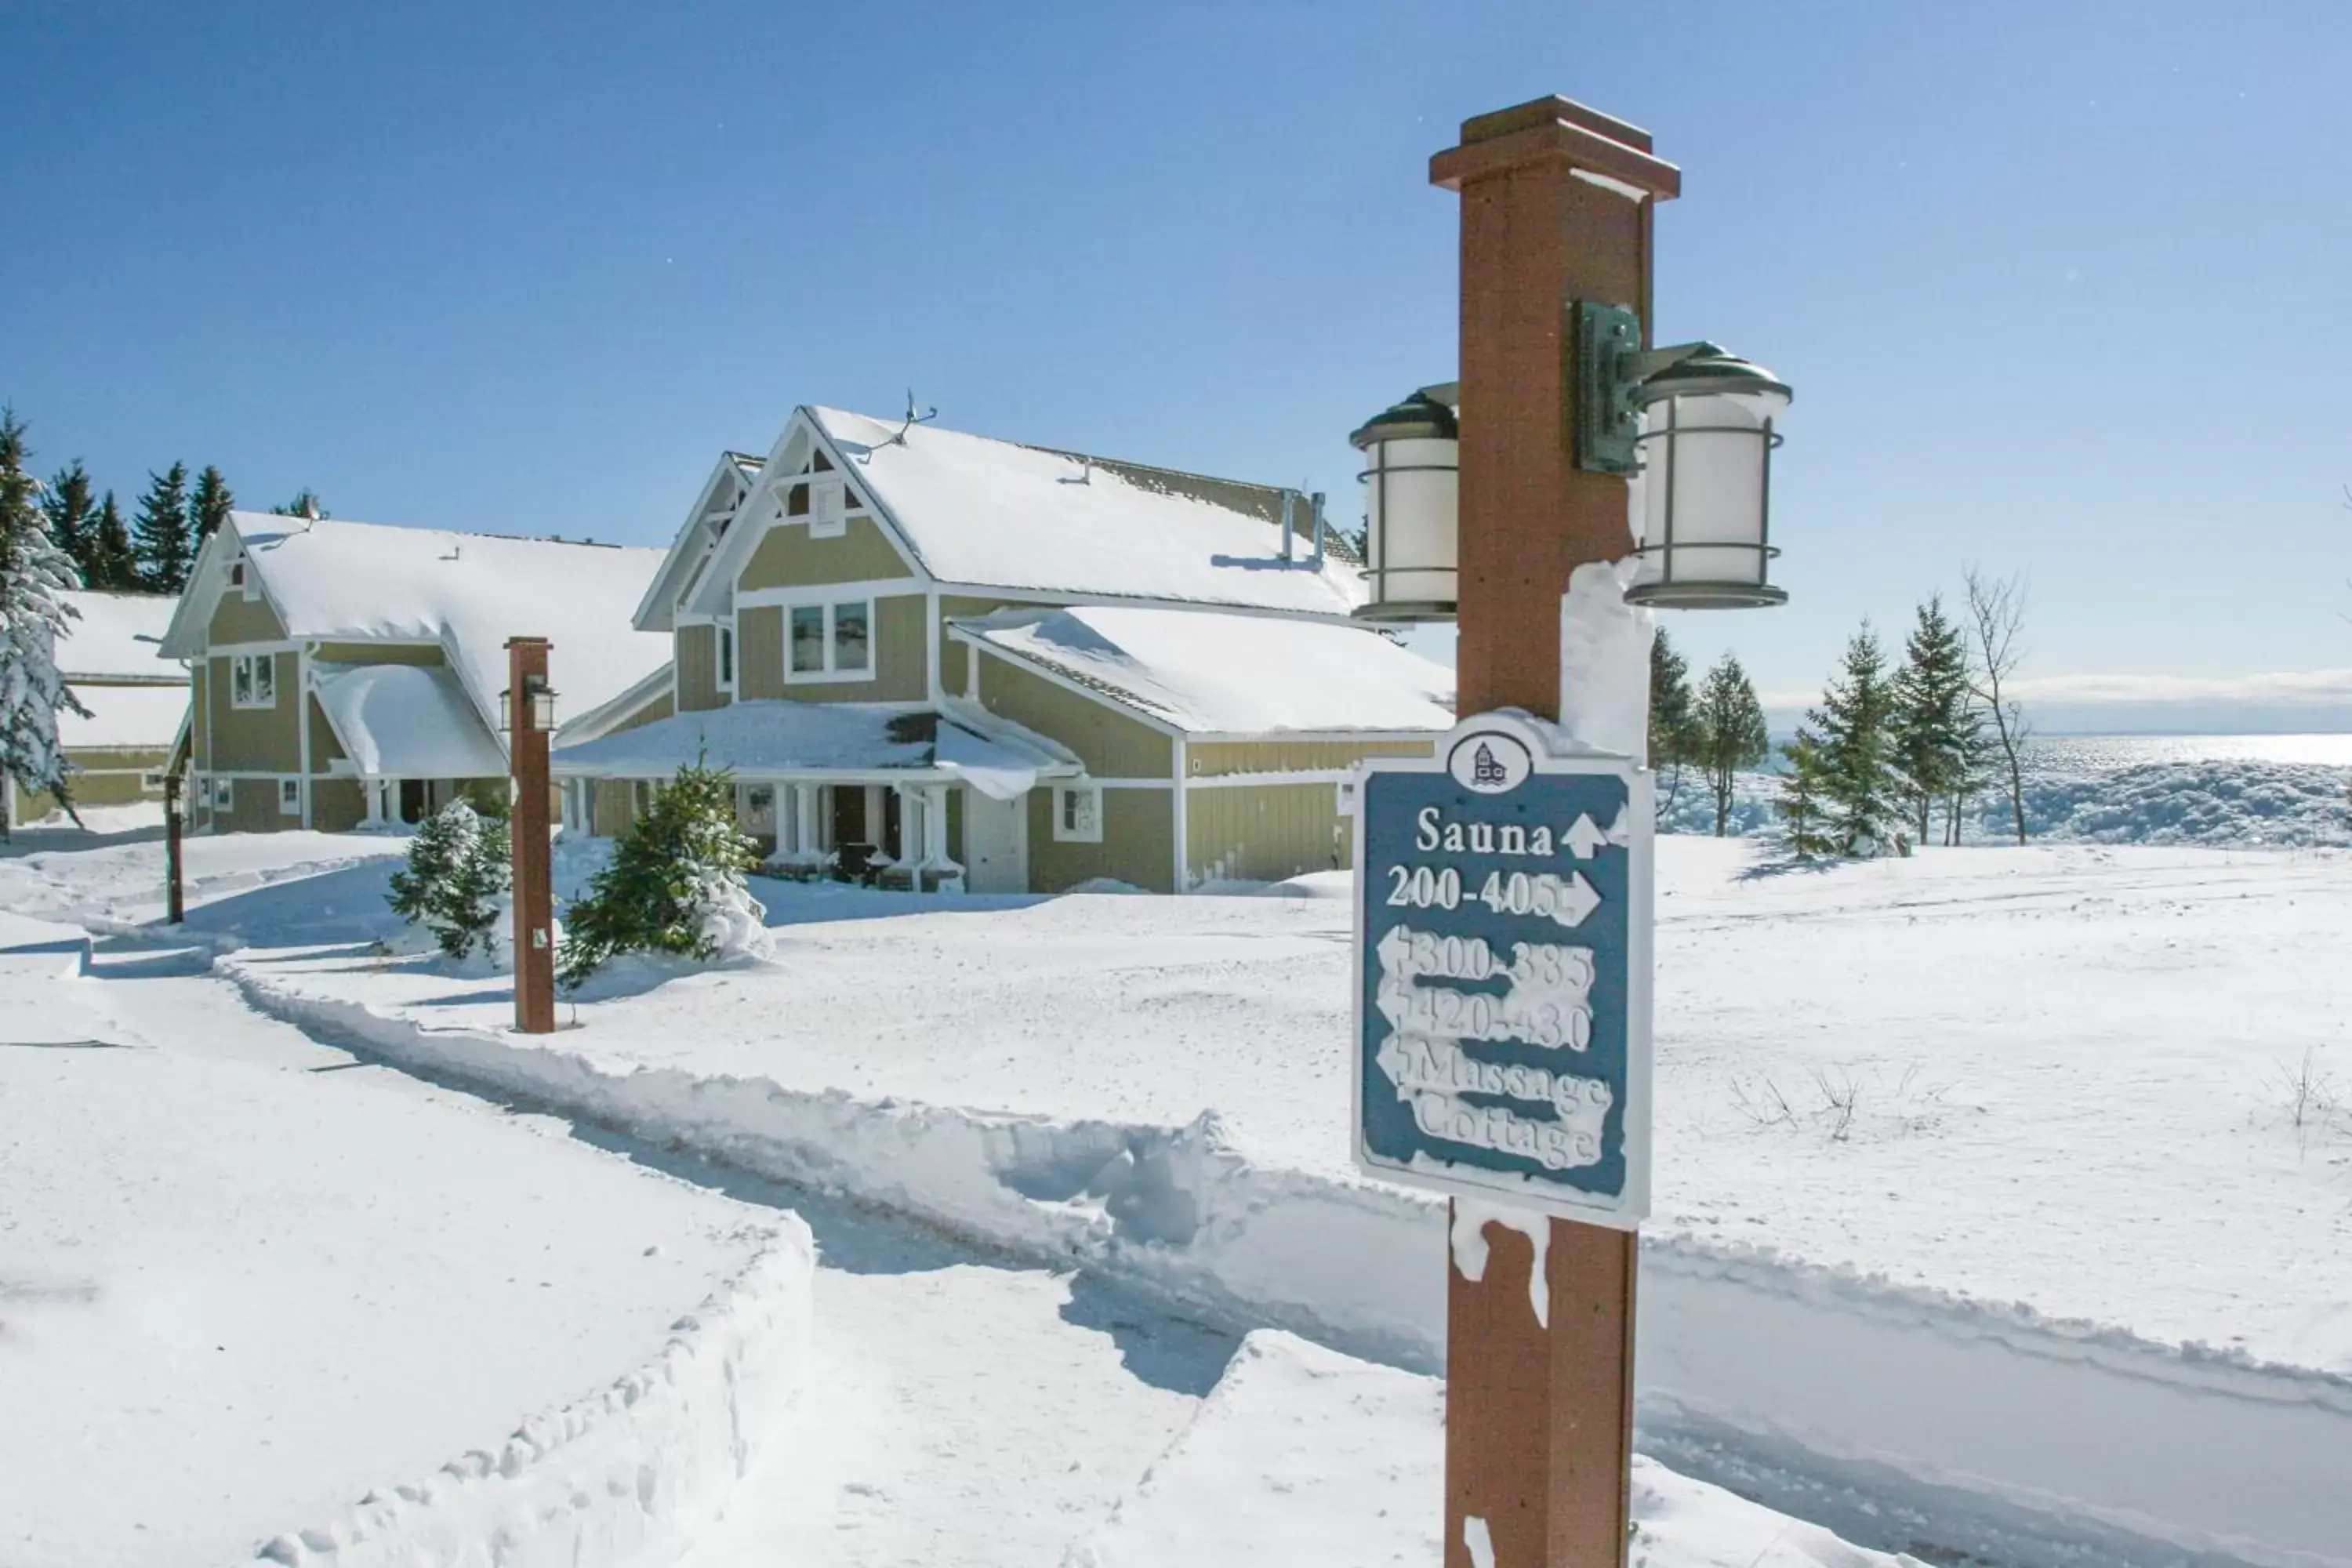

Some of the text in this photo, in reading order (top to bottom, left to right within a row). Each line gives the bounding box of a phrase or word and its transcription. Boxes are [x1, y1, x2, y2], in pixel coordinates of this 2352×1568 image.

[1416, 807, 1555, 856] Sauna
[1385, 865, 1557, 916] 200-405
[1414, 987, 1592, 1052] 420-430
[1413, 1042, 1610, 1114] Massage
[1419, 1095, 1595, 1168] Cottage
